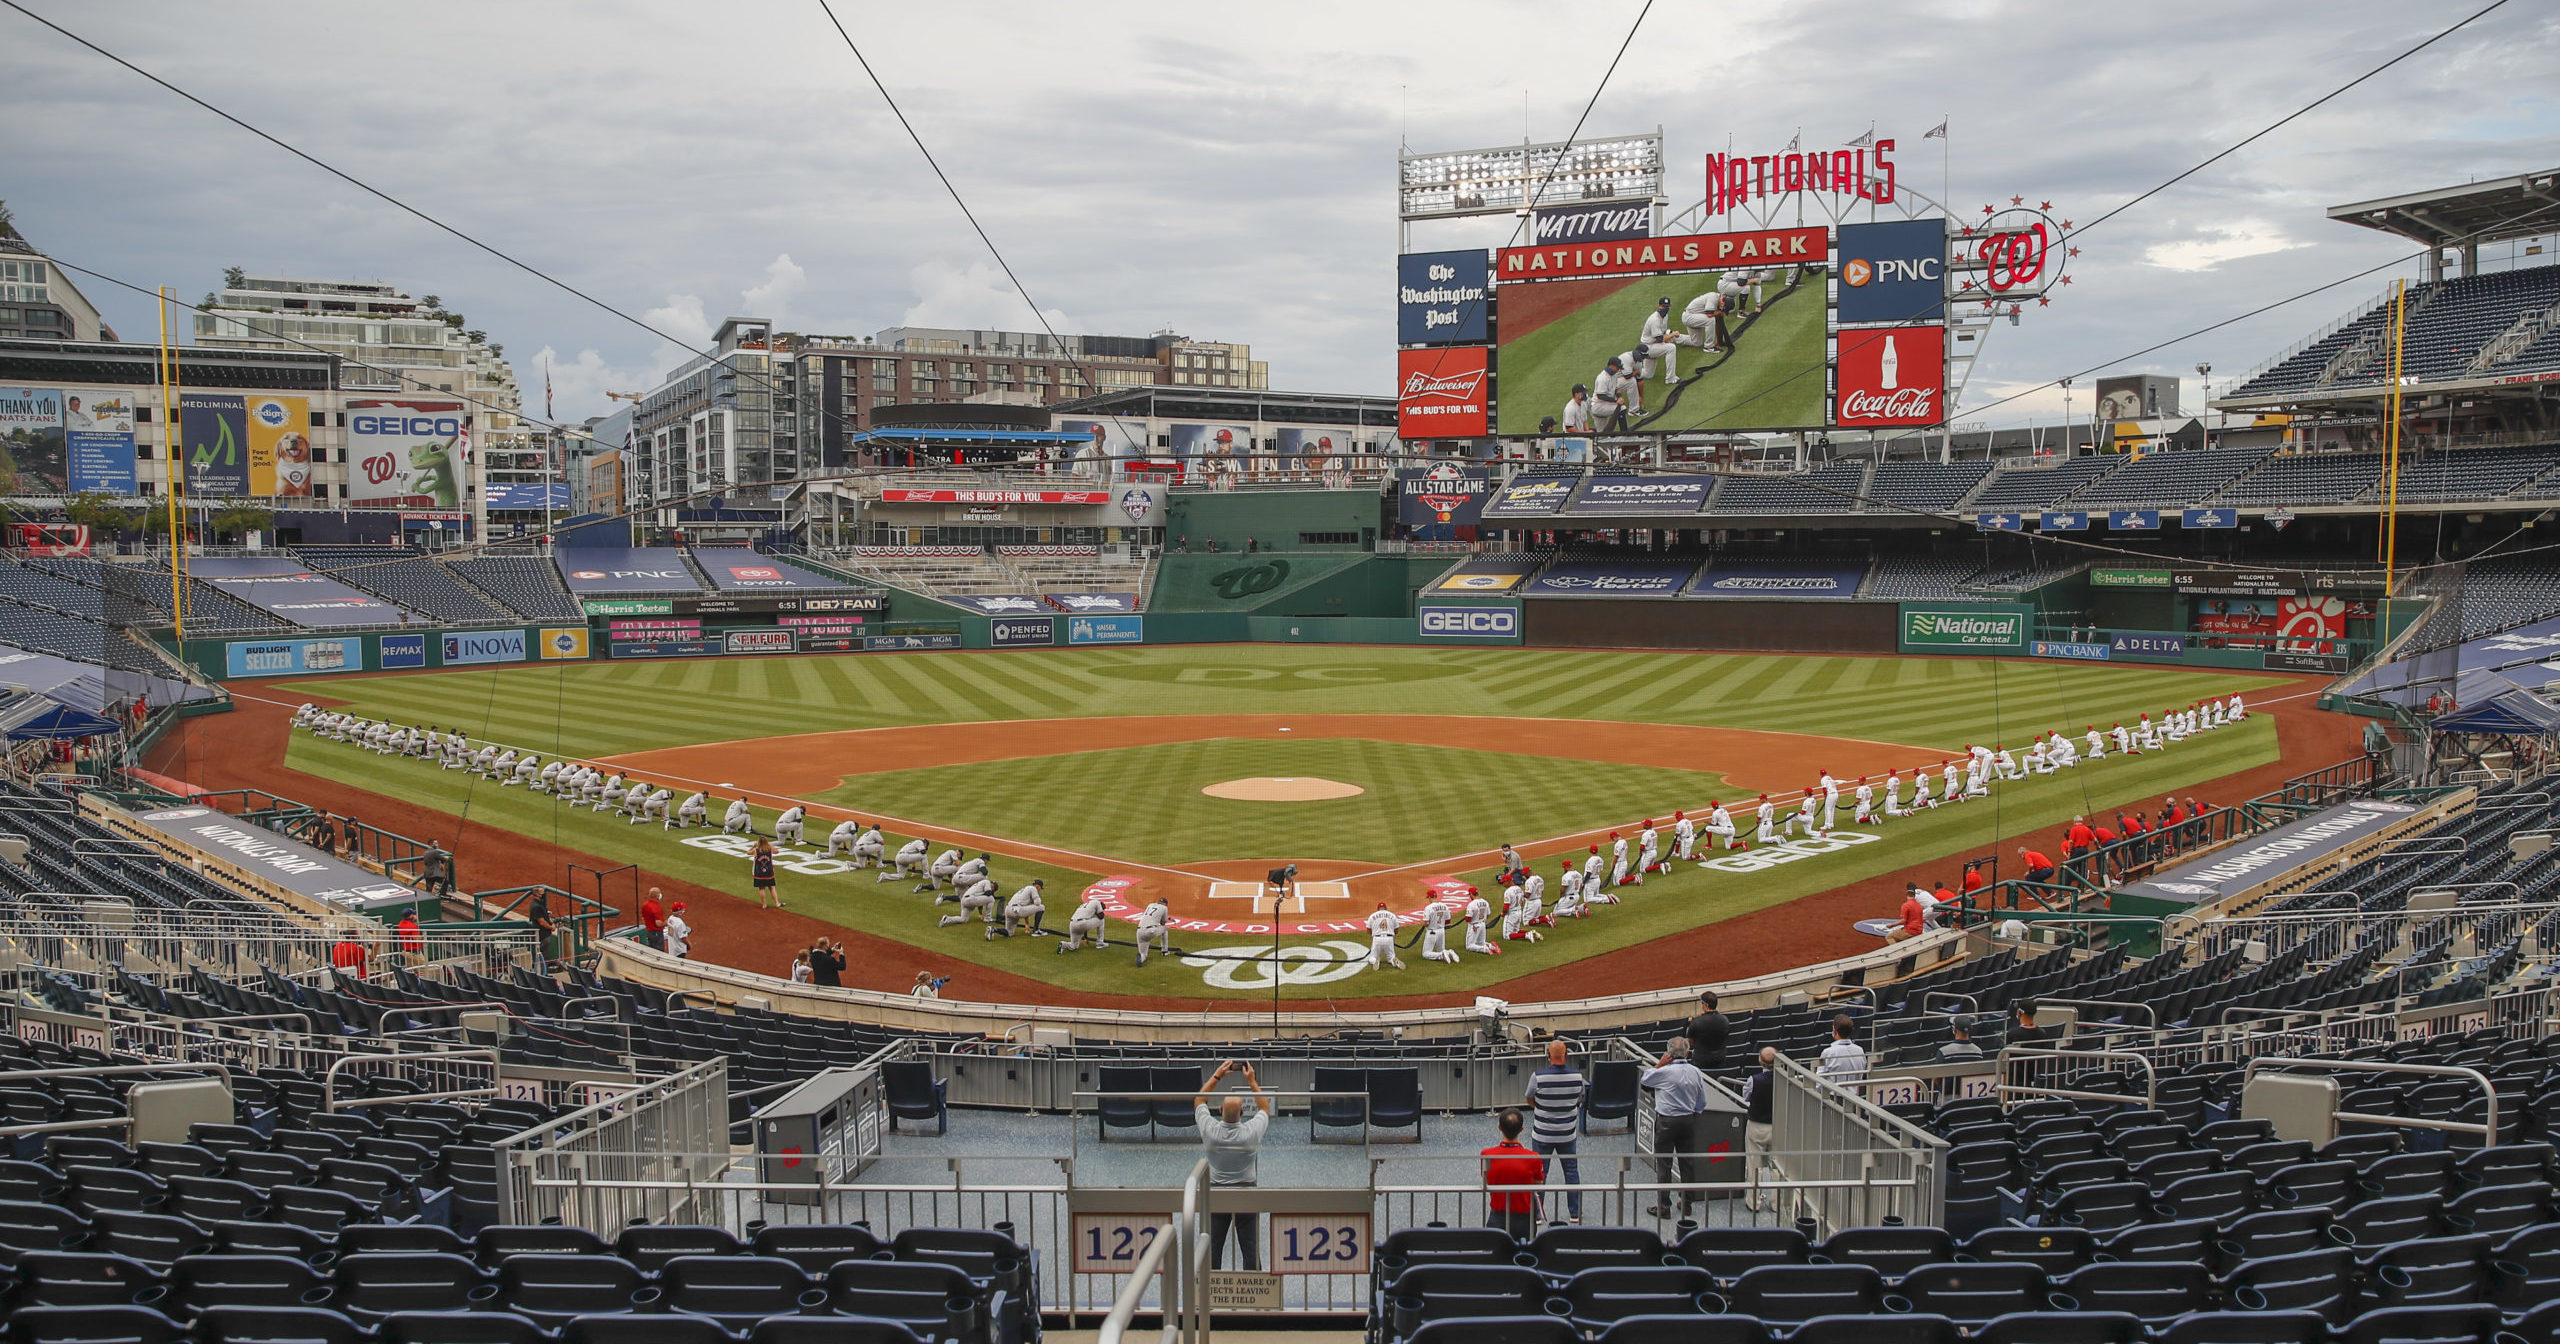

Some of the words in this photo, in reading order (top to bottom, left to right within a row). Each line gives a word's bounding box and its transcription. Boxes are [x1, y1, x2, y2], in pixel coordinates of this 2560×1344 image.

[1705, 139, 1895, 216] NATIONALS
[1536, 207, 1650, 238] NATITUDE
[1508, 243, 1699, 272] NATIONALS
[1719, 235, 1808, 259] PARK
[1429, 264, 1455, 282] The
[1876, 257, 1940, 282] PNC
[1401, 285, 1484, 305] Washington
[1426, 309, 1458, 330] Post
[1406, 378, 1475, 393] Budweiser
[2506, 376, 2534, 384] FRANK
[0, 399, 33, 415] THANK
[37, 397, 56, 415] YOU
[181, 400, 244, 410] MEDLIMINAL
[1405, 406, 1422, 415] THIS
[1424, 406, 1446, 415] BUD'S
[1446, 405, 1461, 414] FOR
[1463, 405, 1479, 414] YOU.
[1843, 388, 1936, 419] Coca-Cola
[0, 414, 28, 422] NATS
[354, 416, 459, 436] GEICO
[1405, 481, 1424, 494] ALL
[1427, 480, 1453, 494] STAR
[1456, 480, 1485, 494] GAME
[955, 491, 975, 501] THIS
[977, 491, 1003, 501] BUD'S
[1004, 491, 1022, 502] FOR
[1024, 492, 1043, 502] YOU.
[609, 570, 684, 578] PNC
[2105, 574, 2135, 584] Harris
[2137, 574, 2169, 584] Teeter
[2175, 575, 2193, 584] 6:55
[2179, 586, 2207, 594] NATIONALS
[600, 604, 634, 613] Harris
[636, 603, 670, 613] Teeter
[778, 601, 797, 610] 6:55
[842, 599, 877, 609] FAN
[1423, 612, 1514, 631] GEICO
[1012, 625, 1050, 633] PENFED
[1097, 631, 1137, 639] PERMANENTE
[875, 637, 895, 645] MGM
[1962, 635, 1978, 643] Car
[1980, 635, 2010, 643] Rental
[2131, 639, 2180, 652] DELTA
[247, 646, 264, 654] BUD
[265, 645, 291, 653] LIGHT
[383, 645, 422, 655] RE/MAX
[465, 638, 523, 655] INOVA
[2336, 644, 2347, 654] 335
[246, 654, 292, 670] SELTZER
[2295, 658, 2324, 667] SoftBank
[190, 824, 287, 861] NATIONALS
[261, 852, 328, 875] PARK
[1698, 831, 1881, 872] GEICO
[2184, 837, 2304, 883] WASHINGTON
[2294, 811, 2384, 847] NATIONALS
[1379, 919, 1388, 930] 4
[23, 1025, 46, 1040] 120
[2403, 1026, 2425, 1040] 124
[80, 1034, 101, 1052] 121
[505, 1084, 536, 1101] 121
[1877, 1087, 1912, 1106] 123
[1283, 1226, 1358, 1261] 123
[1223, 1277, 1234, 1286] BE
[1236, 1277, 1263, 1286] AWARE
[1266, 1277, 1278, 1286] OF
[1236, 1286, 1270, 1295] LEAVING
[1213, 1296, 1229, 1304] THE
[1232, 1296, 1256, 1304] FIELD
